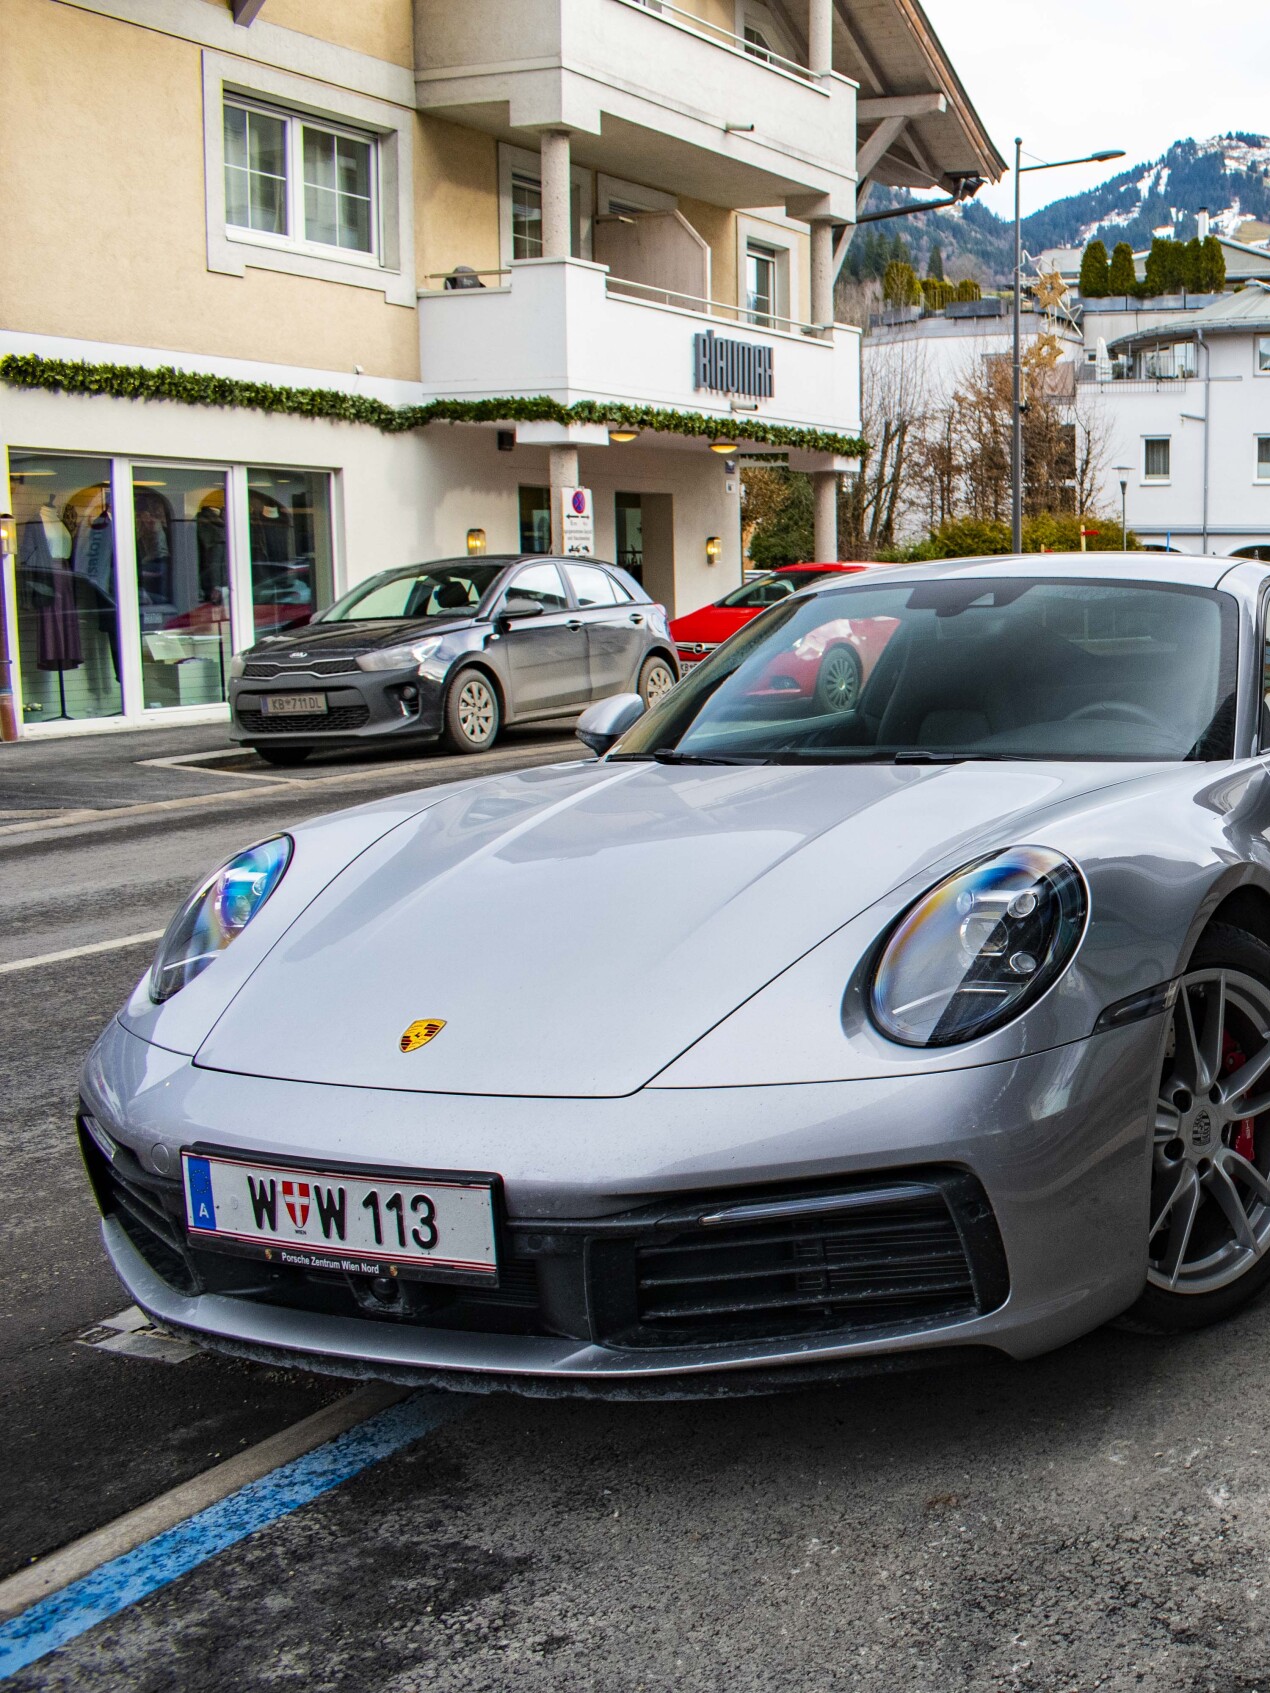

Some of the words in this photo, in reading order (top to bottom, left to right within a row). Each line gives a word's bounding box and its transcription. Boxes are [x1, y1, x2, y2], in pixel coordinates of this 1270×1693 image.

[199, 1202, 210, 1219] A
[247, 1174, 277, 1232] W
[313, 1184, 346, 1242] W
[362, 1189, 439, 1250] 113
[281, 1252, 310, 1265] Porsche
[311, 1256, 340, 1270] Zentrum
[341, 1260, 360, 1272] Wien
[361, 1263, 380, 1274] Nord
